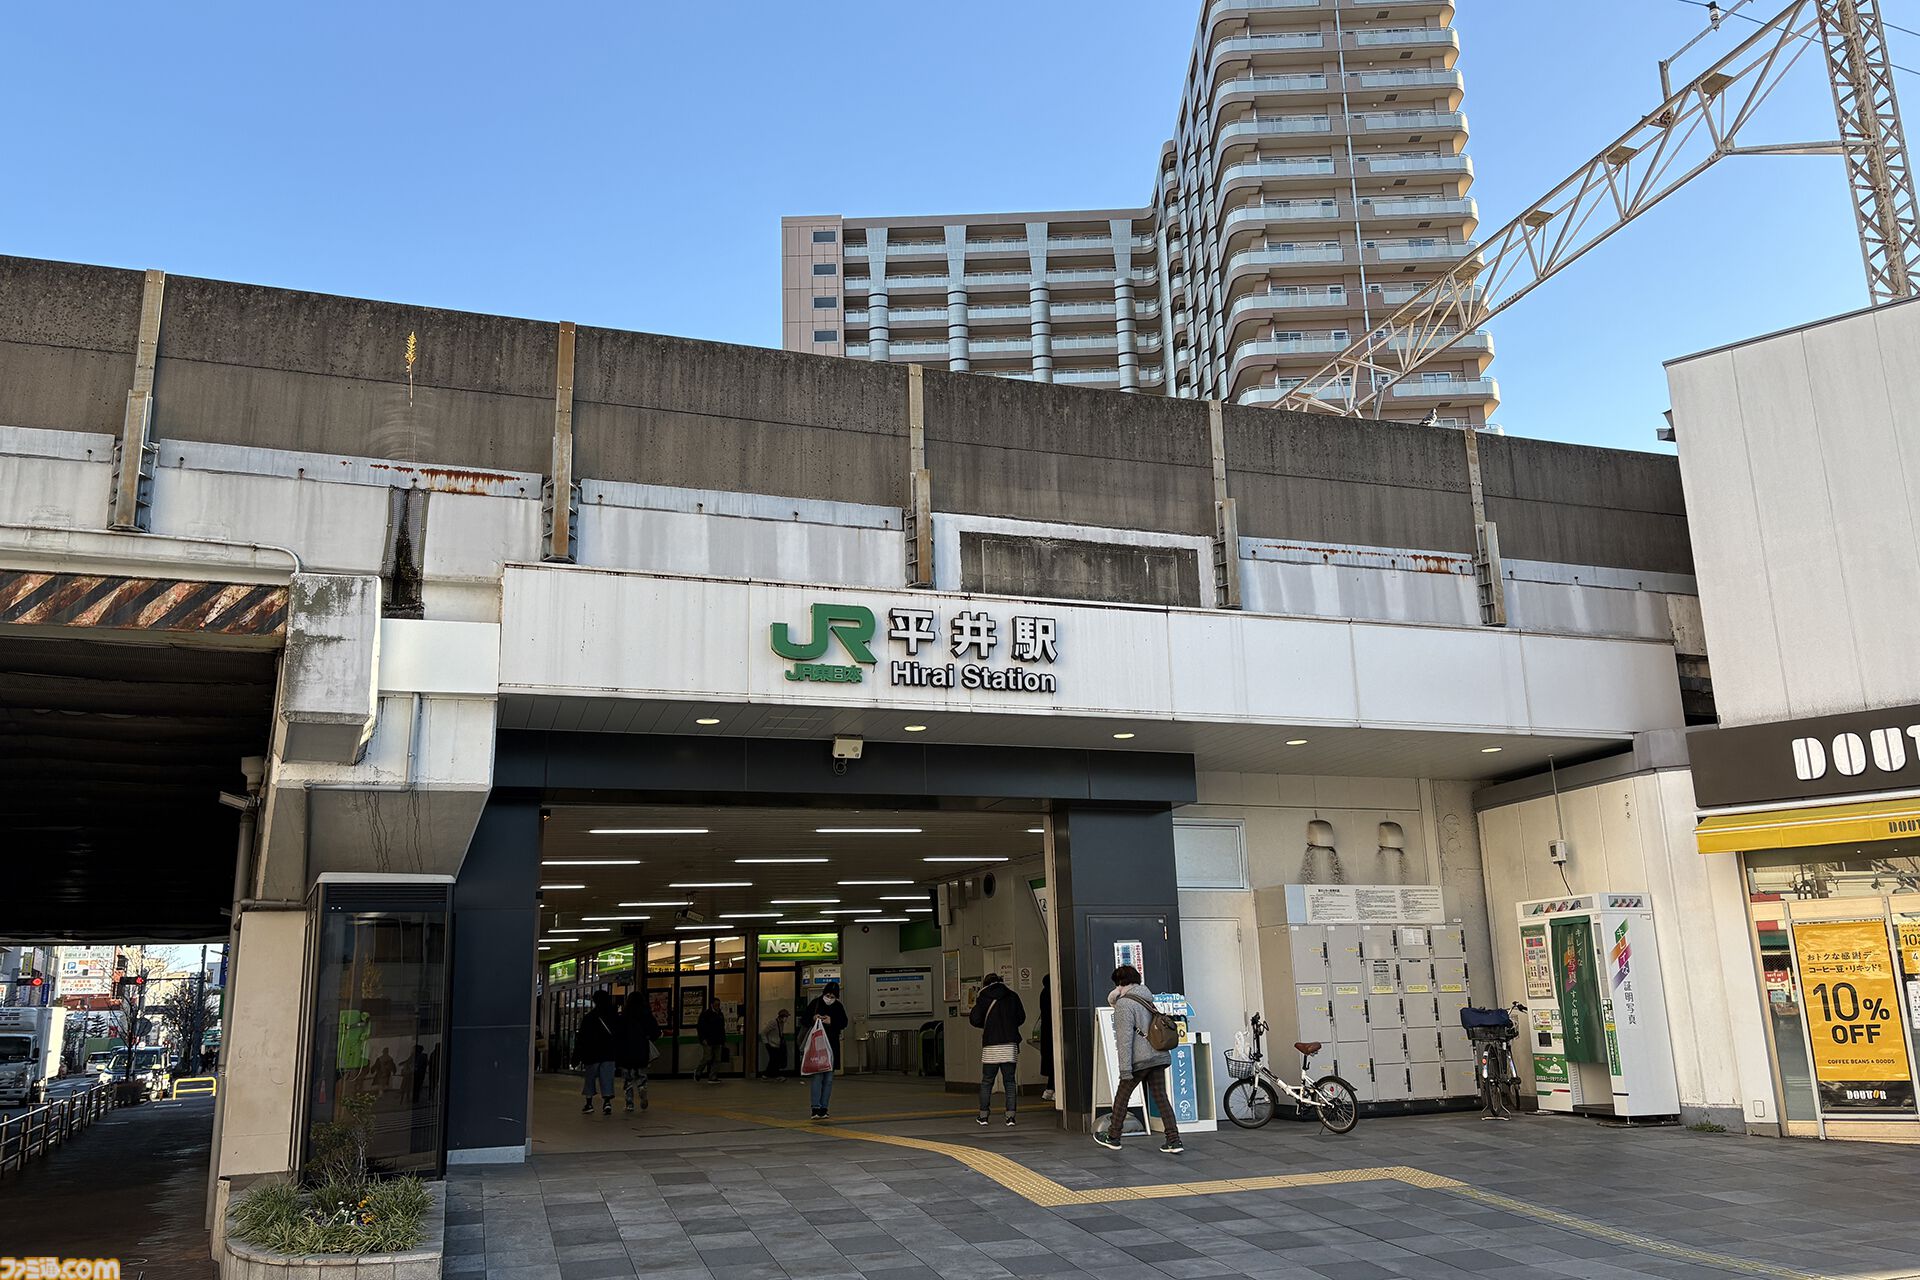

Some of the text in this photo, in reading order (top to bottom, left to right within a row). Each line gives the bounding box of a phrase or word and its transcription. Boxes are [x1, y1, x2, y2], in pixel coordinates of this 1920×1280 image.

[770, 603, 878, 664] JR
[888, 607, 1058, 664] 平井駅
[785, 663, 862, 683] JR東日本
[891, 661, 1057, 693] Hirai Station
[766, 940, 833, 955] NewDays
[1566, 933, 1577, 984] 証明写真
[1575, 929, 1583, 966] キレイな
[1616, 928, 1630, 974] キレイな
[1570, 990, 1581, 1044] すぐ出来ます
[1624, 981, 1636, 1025] 証明写真
[1813, 982, 1890, 1021] 10%
[1832, 1024, 1881, 1044] OFF
[1177, 1050, 1187, 1095] 傘レンタル
[1846, 1089, 1887, 1100] DOUTOR
